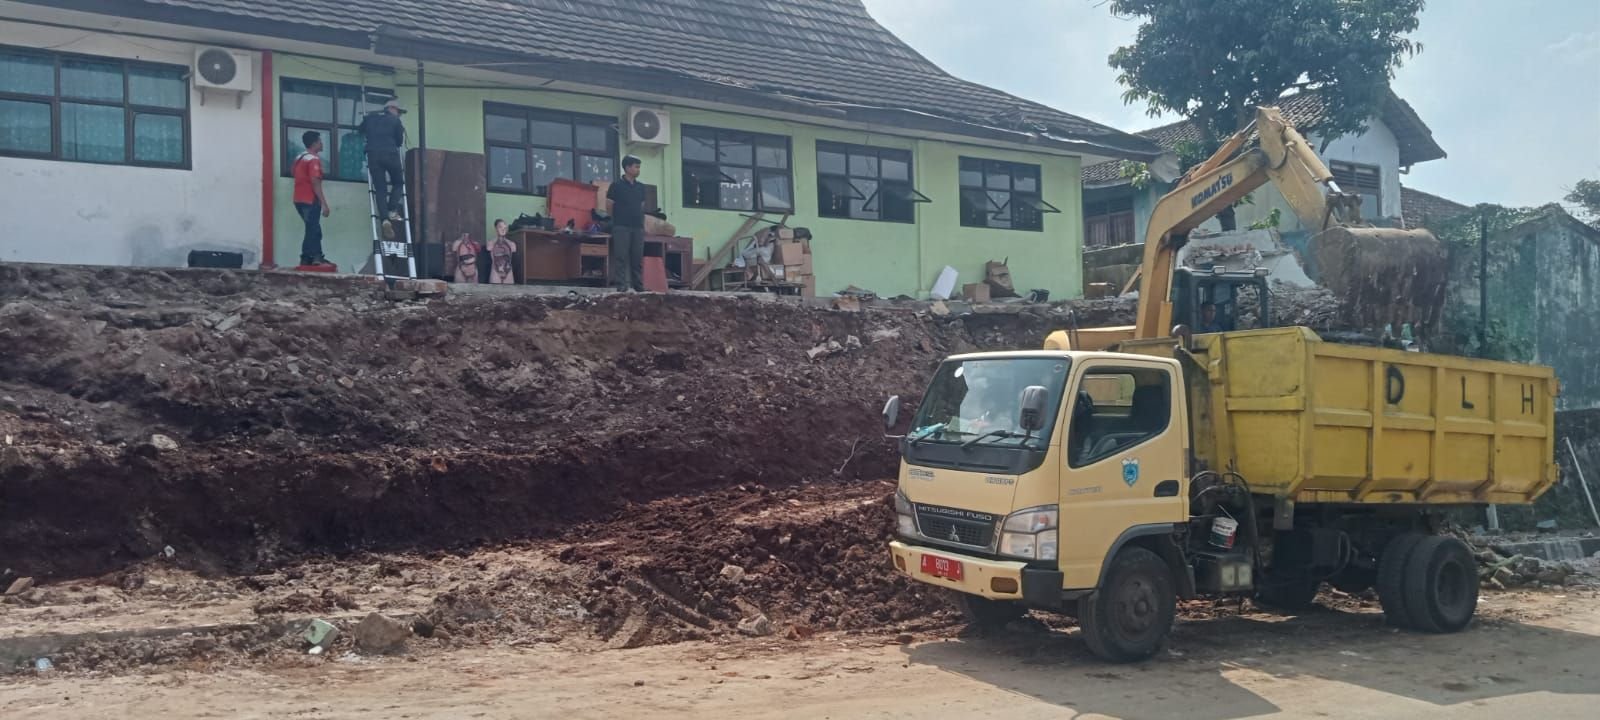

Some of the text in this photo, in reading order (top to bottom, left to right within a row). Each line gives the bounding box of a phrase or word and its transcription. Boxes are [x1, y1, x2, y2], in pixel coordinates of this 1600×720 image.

[1191, 172, 1233, 209] KOMATSU
[1386, 364, 1534, 415] D L H
[918, 505, 993, 521] MITSUBISHI FUSO
